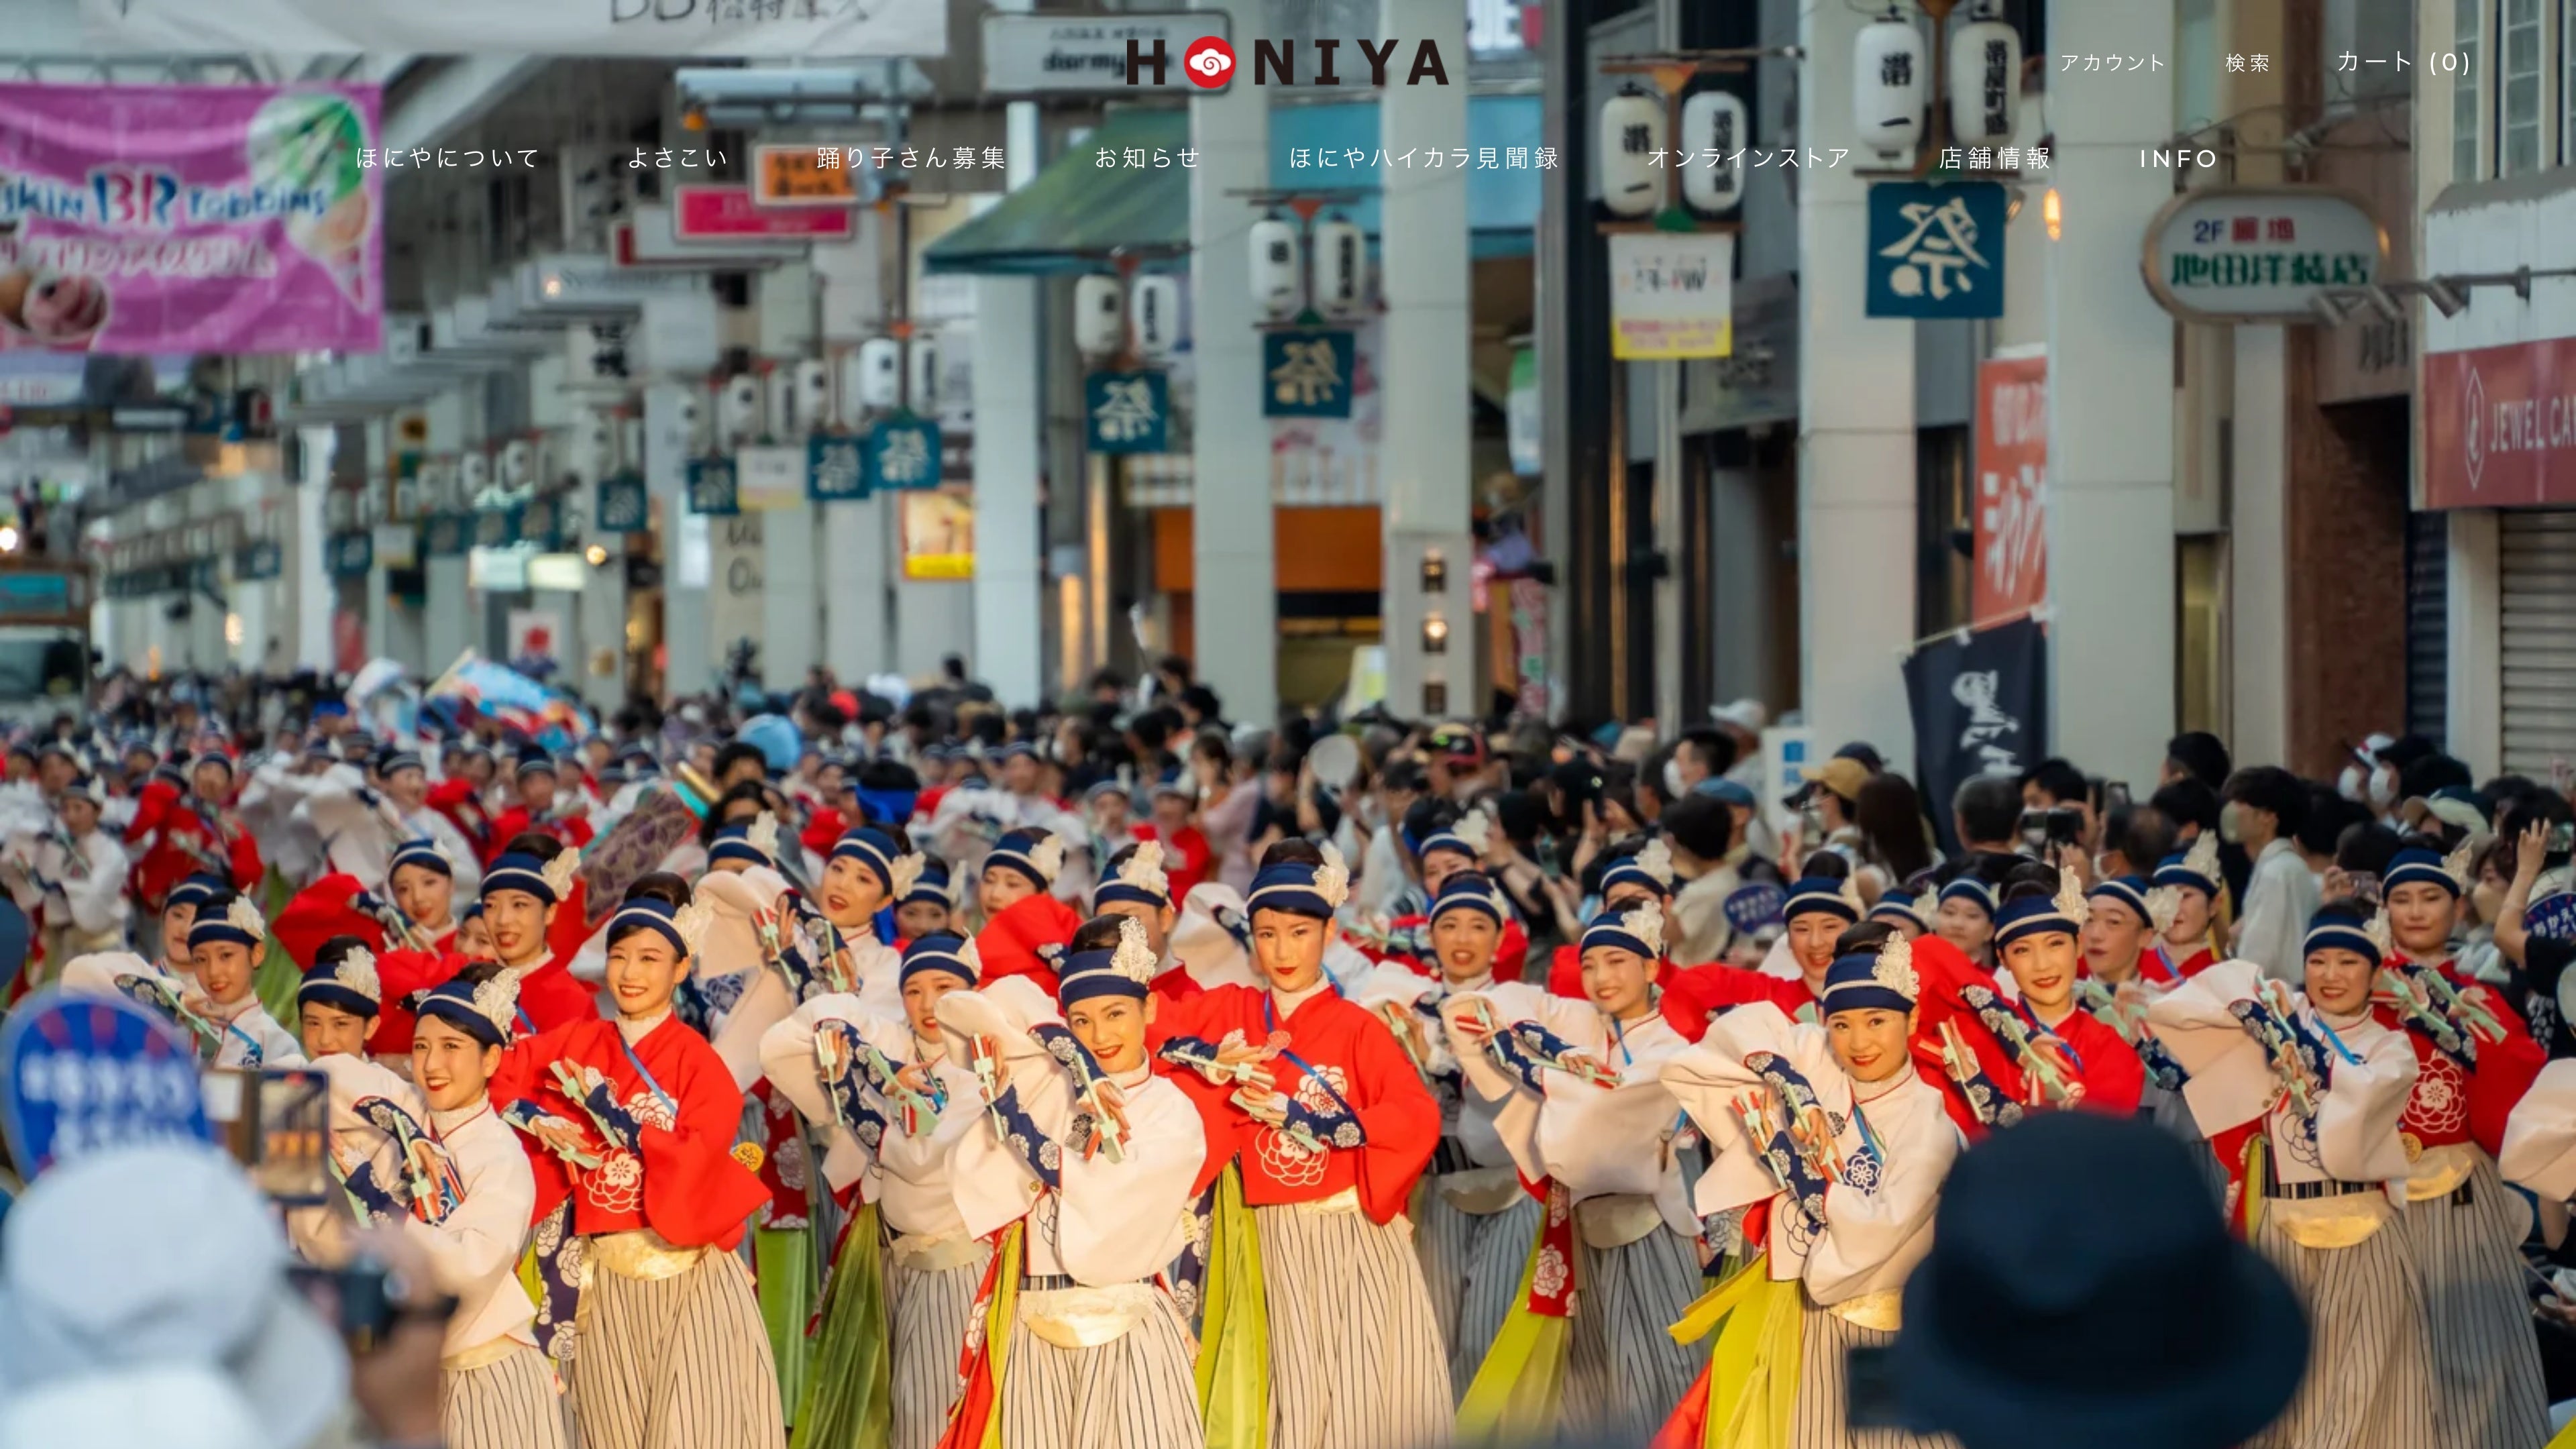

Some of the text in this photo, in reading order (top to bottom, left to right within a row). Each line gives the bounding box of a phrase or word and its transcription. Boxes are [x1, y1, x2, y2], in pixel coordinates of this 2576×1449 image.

[93, 172, 179, 225] BR
[2193, 219, 2224, 244] 2F
[2171, 252, 2370, 287] 池田洋装店
[2490, 394, 2576, 453] JEWEL CA
